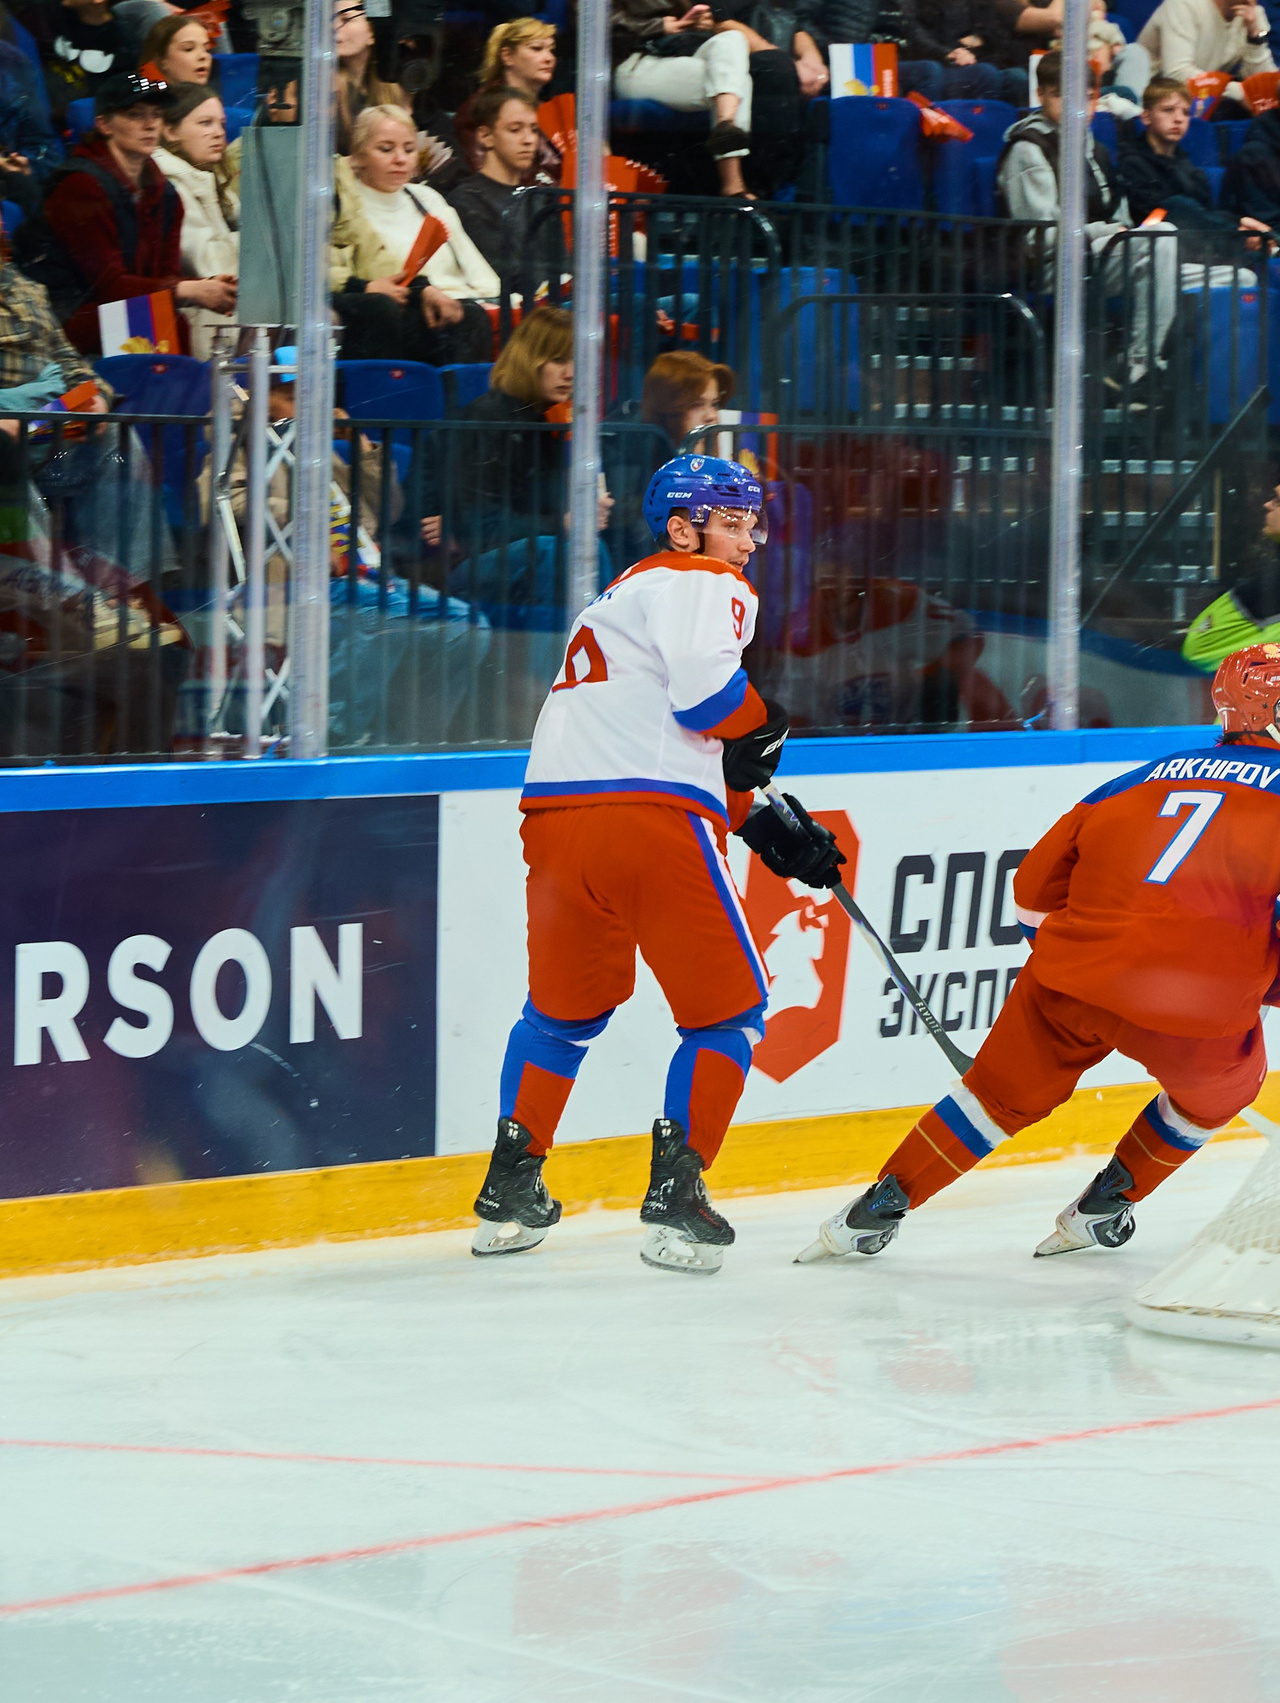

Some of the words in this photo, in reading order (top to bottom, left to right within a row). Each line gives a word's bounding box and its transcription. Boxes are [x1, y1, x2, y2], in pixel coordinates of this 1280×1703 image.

[1144, 789, 1226, 885] 7
[14, 923, 363, 1066] RSON
[880, 966, 1024, 1037] ЭКСП
[914, 1001, 942, 1033] FLYLITE
